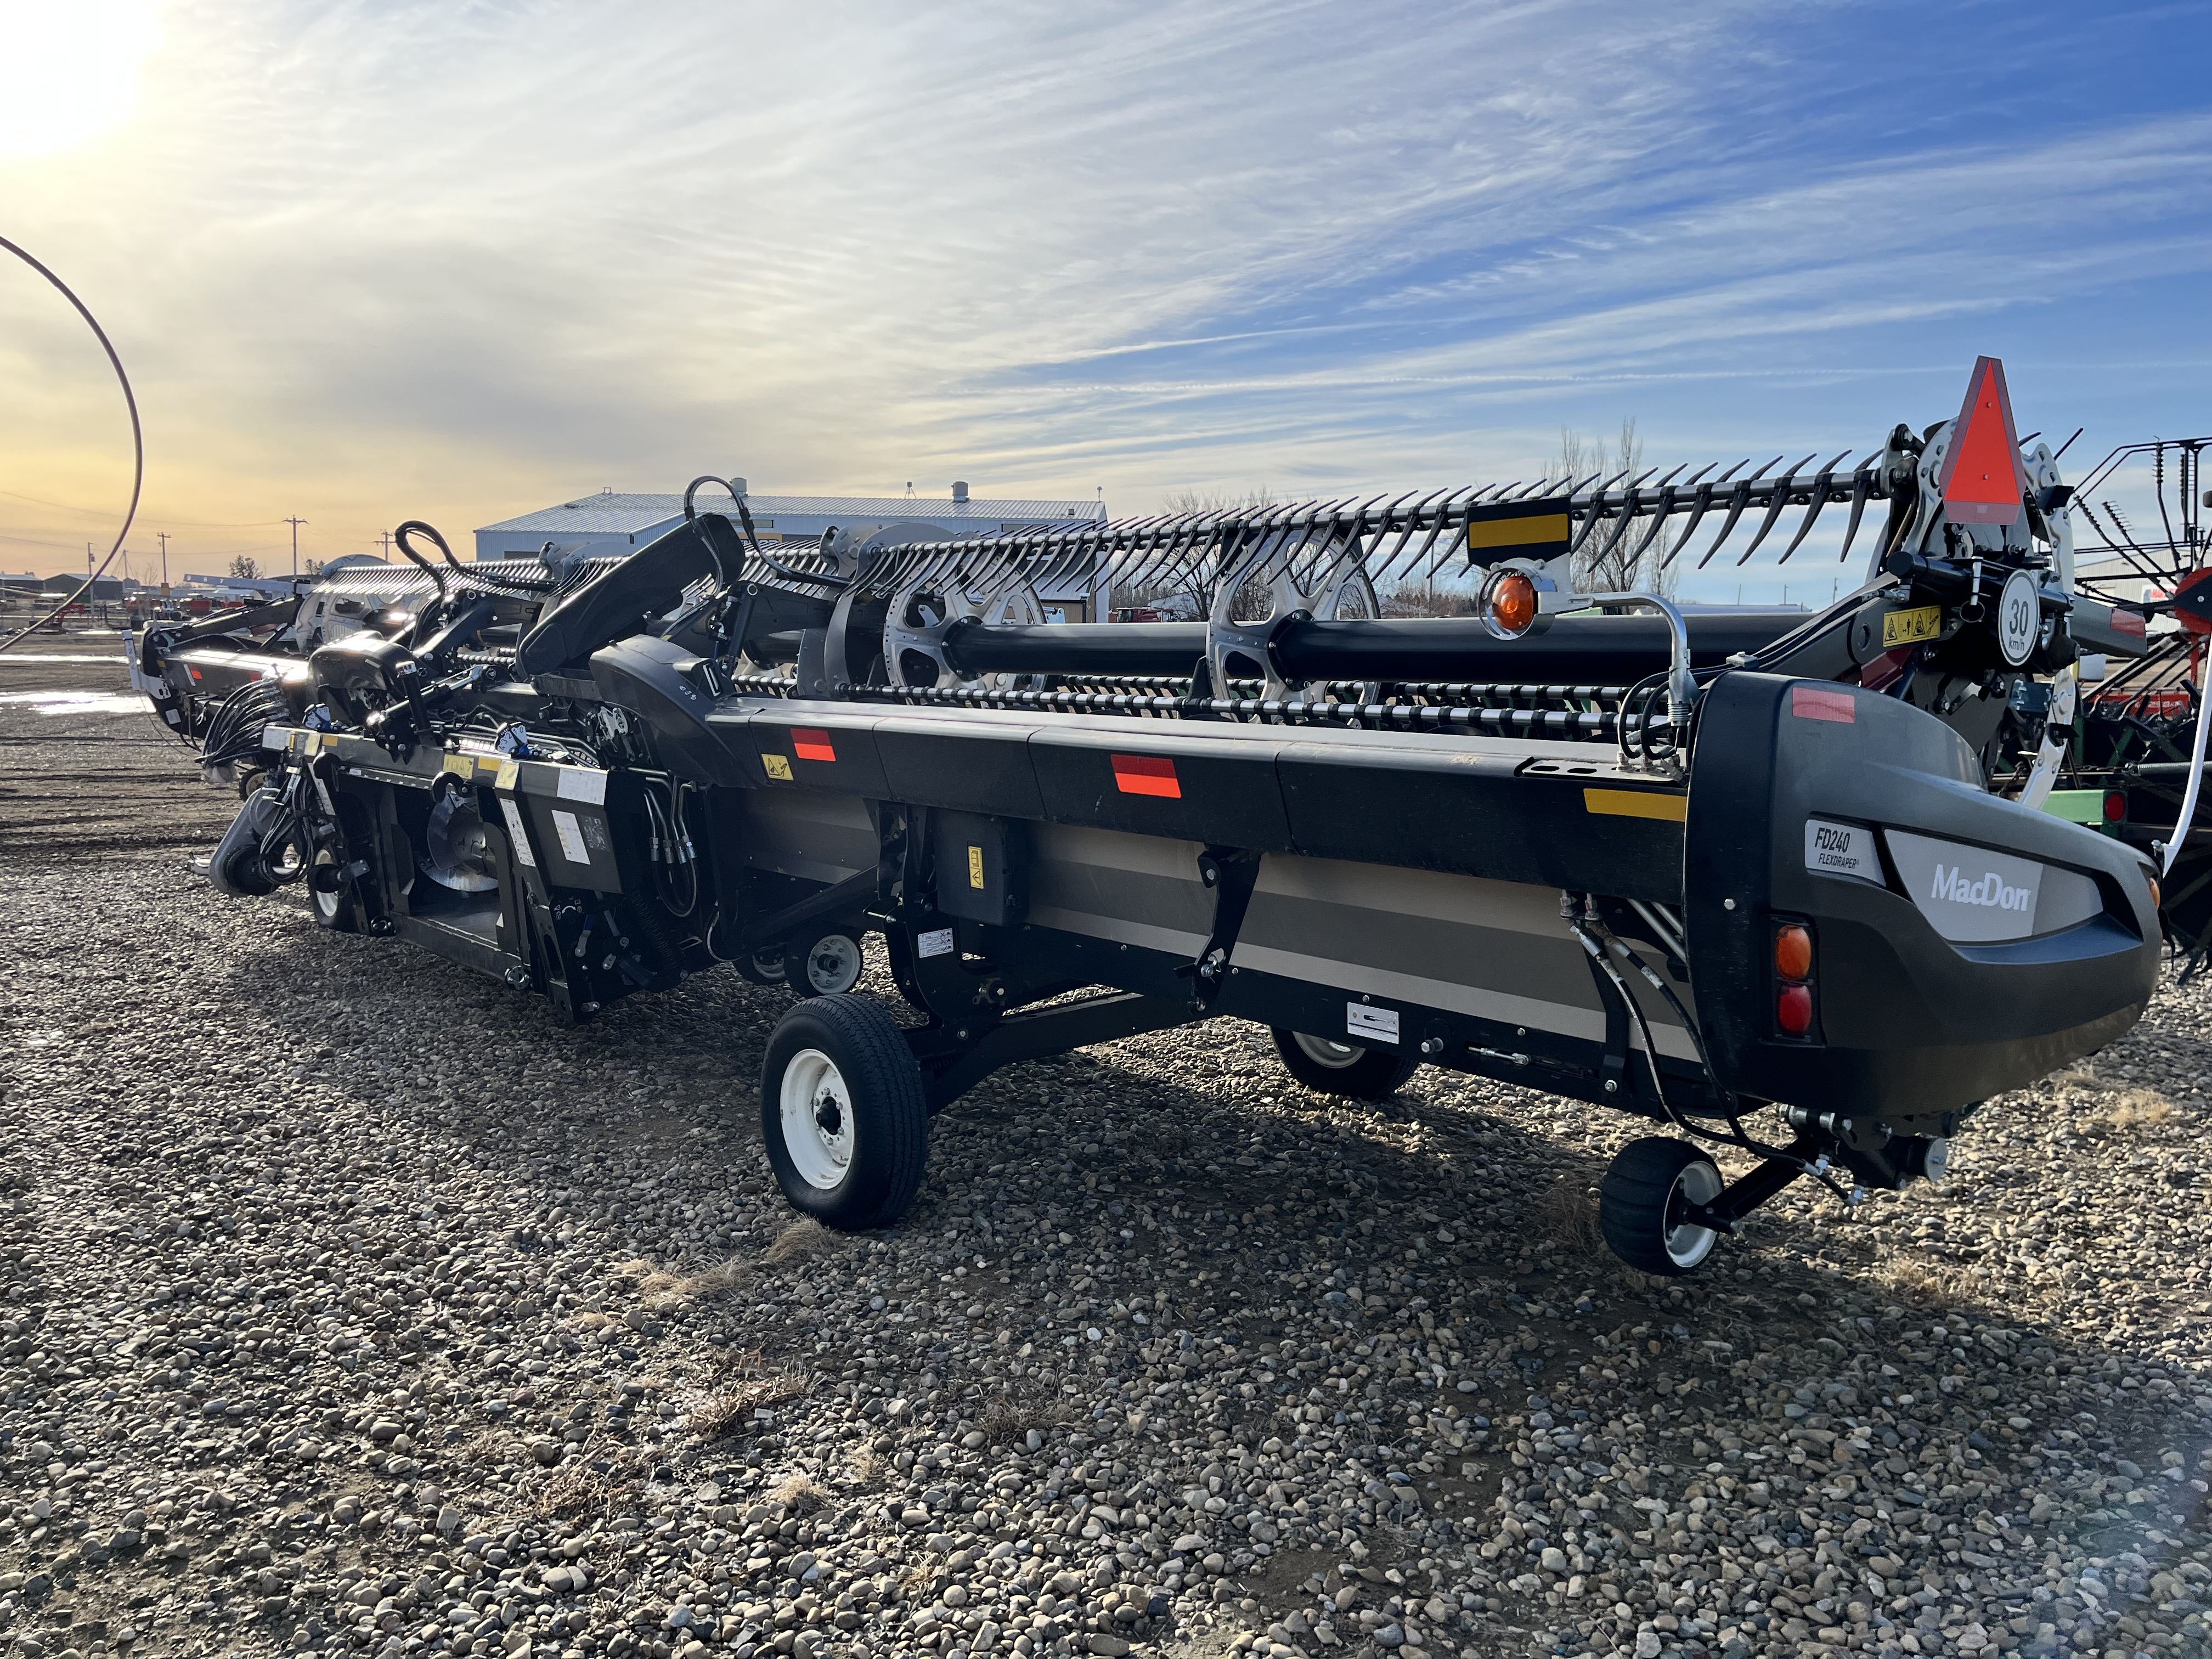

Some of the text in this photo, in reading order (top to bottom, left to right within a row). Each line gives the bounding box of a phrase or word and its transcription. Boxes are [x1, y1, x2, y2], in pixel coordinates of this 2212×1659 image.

[2009, 598, 2029, 637] 30
[2008, 636, 2025, 652] km/h
[1814, 827, 1850, 853] FD240
[1931, 864, 2029, 911] MacDon
